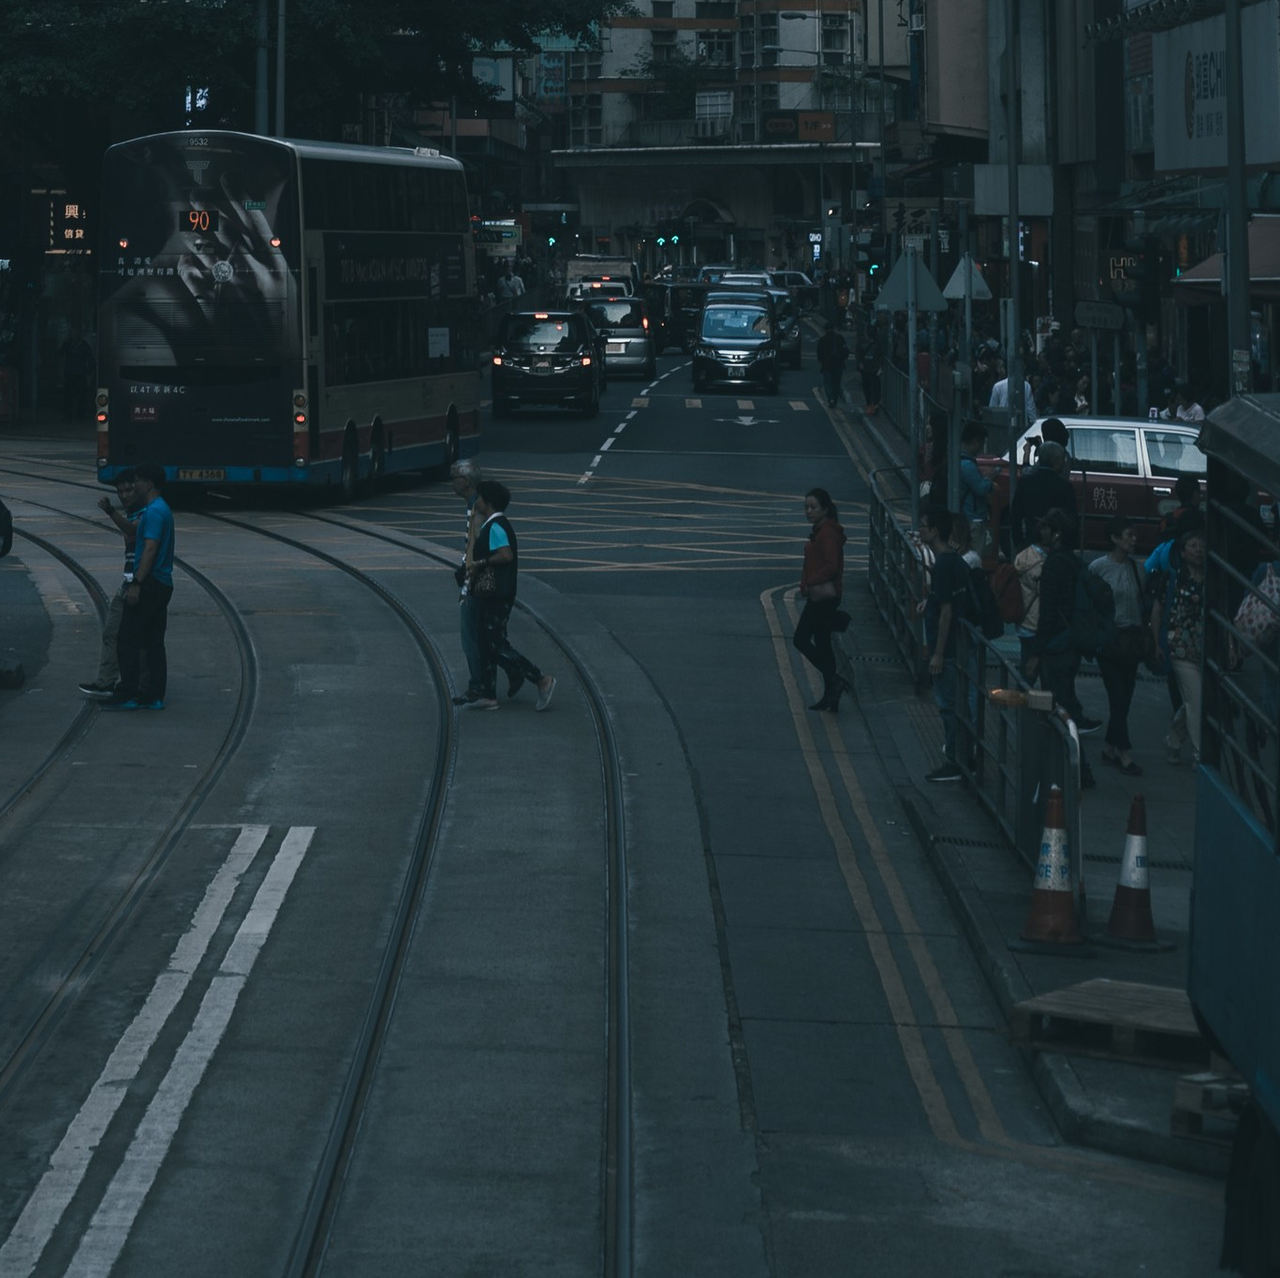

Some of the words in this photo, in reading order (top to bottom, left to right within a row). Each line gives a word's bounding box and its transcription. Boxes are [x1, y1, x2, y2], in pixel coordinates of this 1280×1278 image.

[189, 138, 208, 146] 9532
[189, 211, 210, 231] 90
[182, 469, 194, 479] TY
[1094, 487, 1116, 499] 的士
[1094, 499, 1118, 510] TAXI
